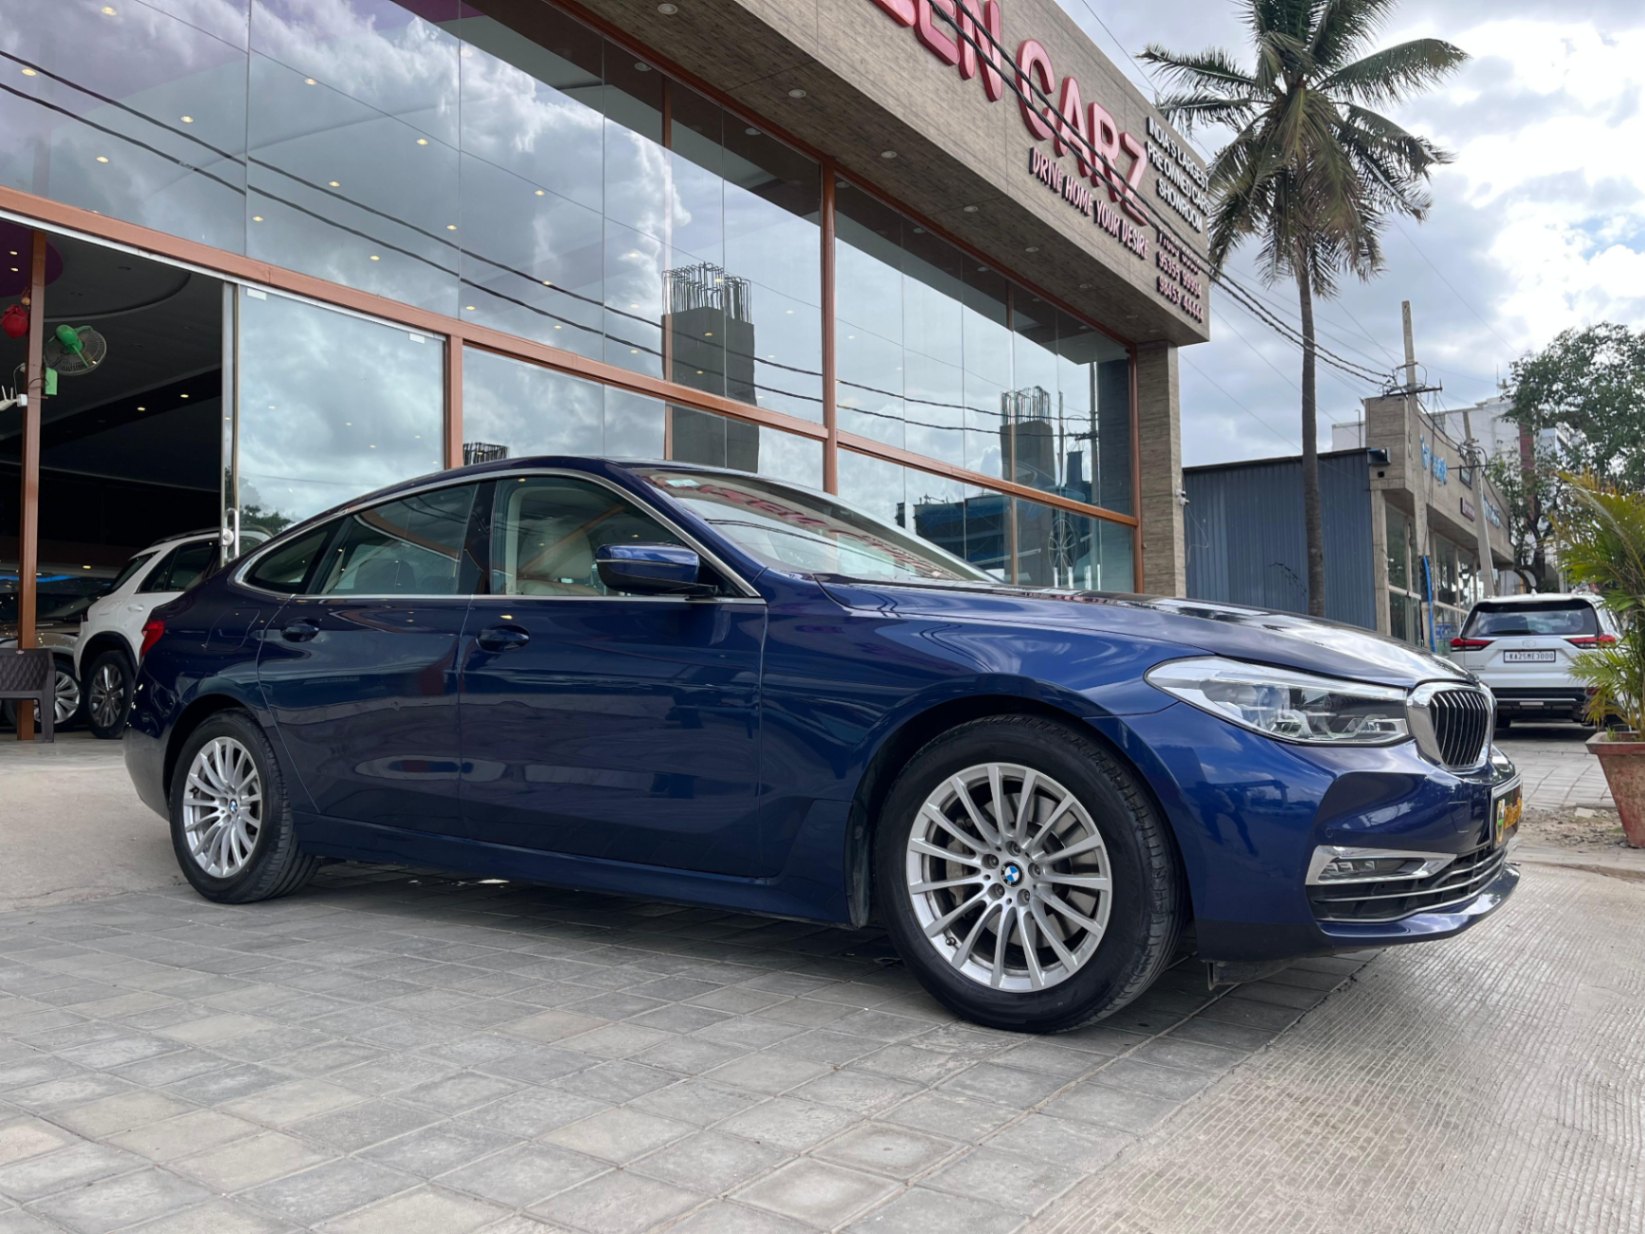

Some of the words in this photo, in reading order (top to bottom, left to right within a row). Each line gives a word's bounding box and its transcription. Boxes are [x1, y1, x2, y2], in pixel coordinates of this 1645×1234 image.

[869, 0, 1003, 102] EN
[1015, 39, 1148, 226] CARZ
[1146, 140, 1164, 172] PRE
[1163, 158, 1192, 198] OWNED
[1176, 144, 1209, 192] LARGEST
[1030, 147, 1062, 194] DRIVE
[1063, 175, 1093, 216] HOME
[1094, 200, 1120, 238] YOUR
[1120, 219, 1149, 260] DESIRE
[1158, 178, 1203, 233] SHOWROOM
